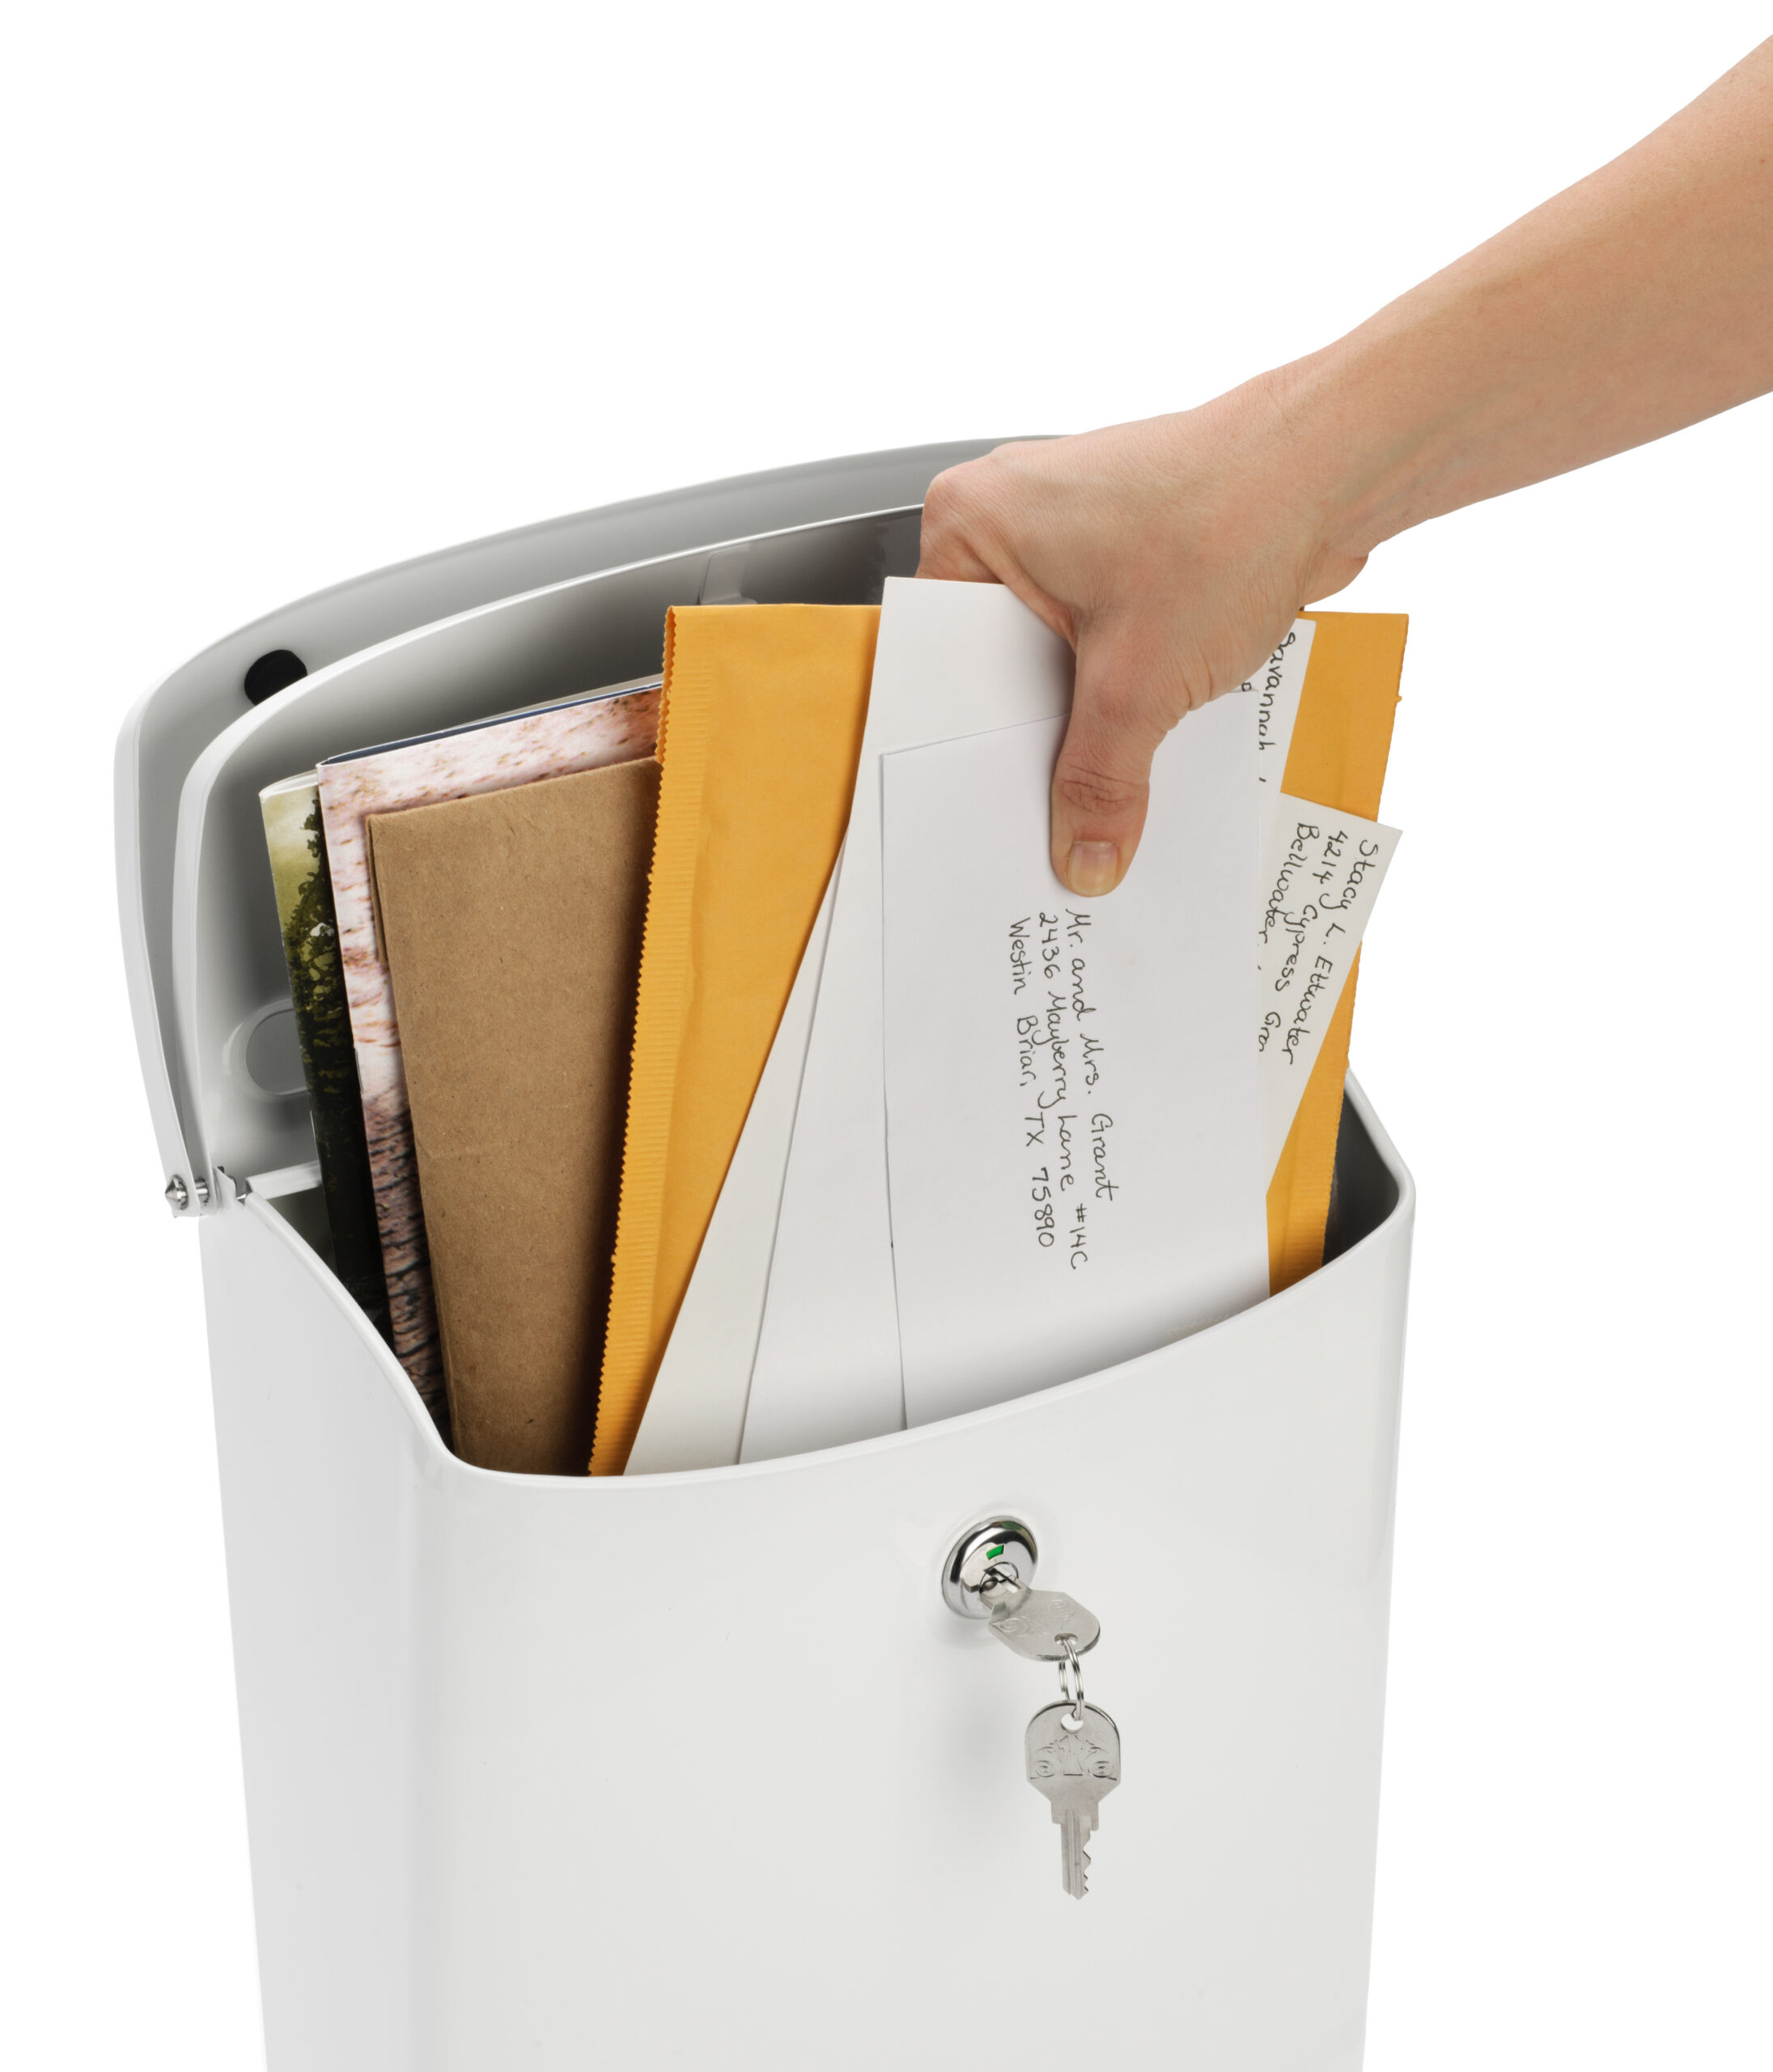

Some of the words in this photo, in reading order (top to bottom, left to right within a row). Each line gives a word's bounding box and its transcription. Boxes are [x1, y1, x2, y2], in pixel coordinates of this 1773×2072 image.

[1313, 830, 1348, 884] 4214
[1319, 839, 1379, 911] Stacy
[1008, 917, 1032, 995] Westin
[1039, 912, 1062, 979] 2436
[1066, 908, 1092, 948] Mr.
[1275, 904, 1318, 991] Cypress
[1324, 923, 1347, 945] L.
[1071, 958, 1096, 1021] and
[1282, 955, 1333, 1065] Ettwater
[1016, 1016, 1038, 1087] Briar,
[1032, 991, 1070, 1109] Mayberry
[1079, 1034, 1104, 1094] Mrs.
[1024, 1112, 1045, 1147] TX
[1058, 1115, 1078, 1191] Lane
[1091, 1113, 1119, 1201] Grant
[1031, 1167, 1055, 1247] 75890
[1070, 1203, 1088, 1270] #14C
